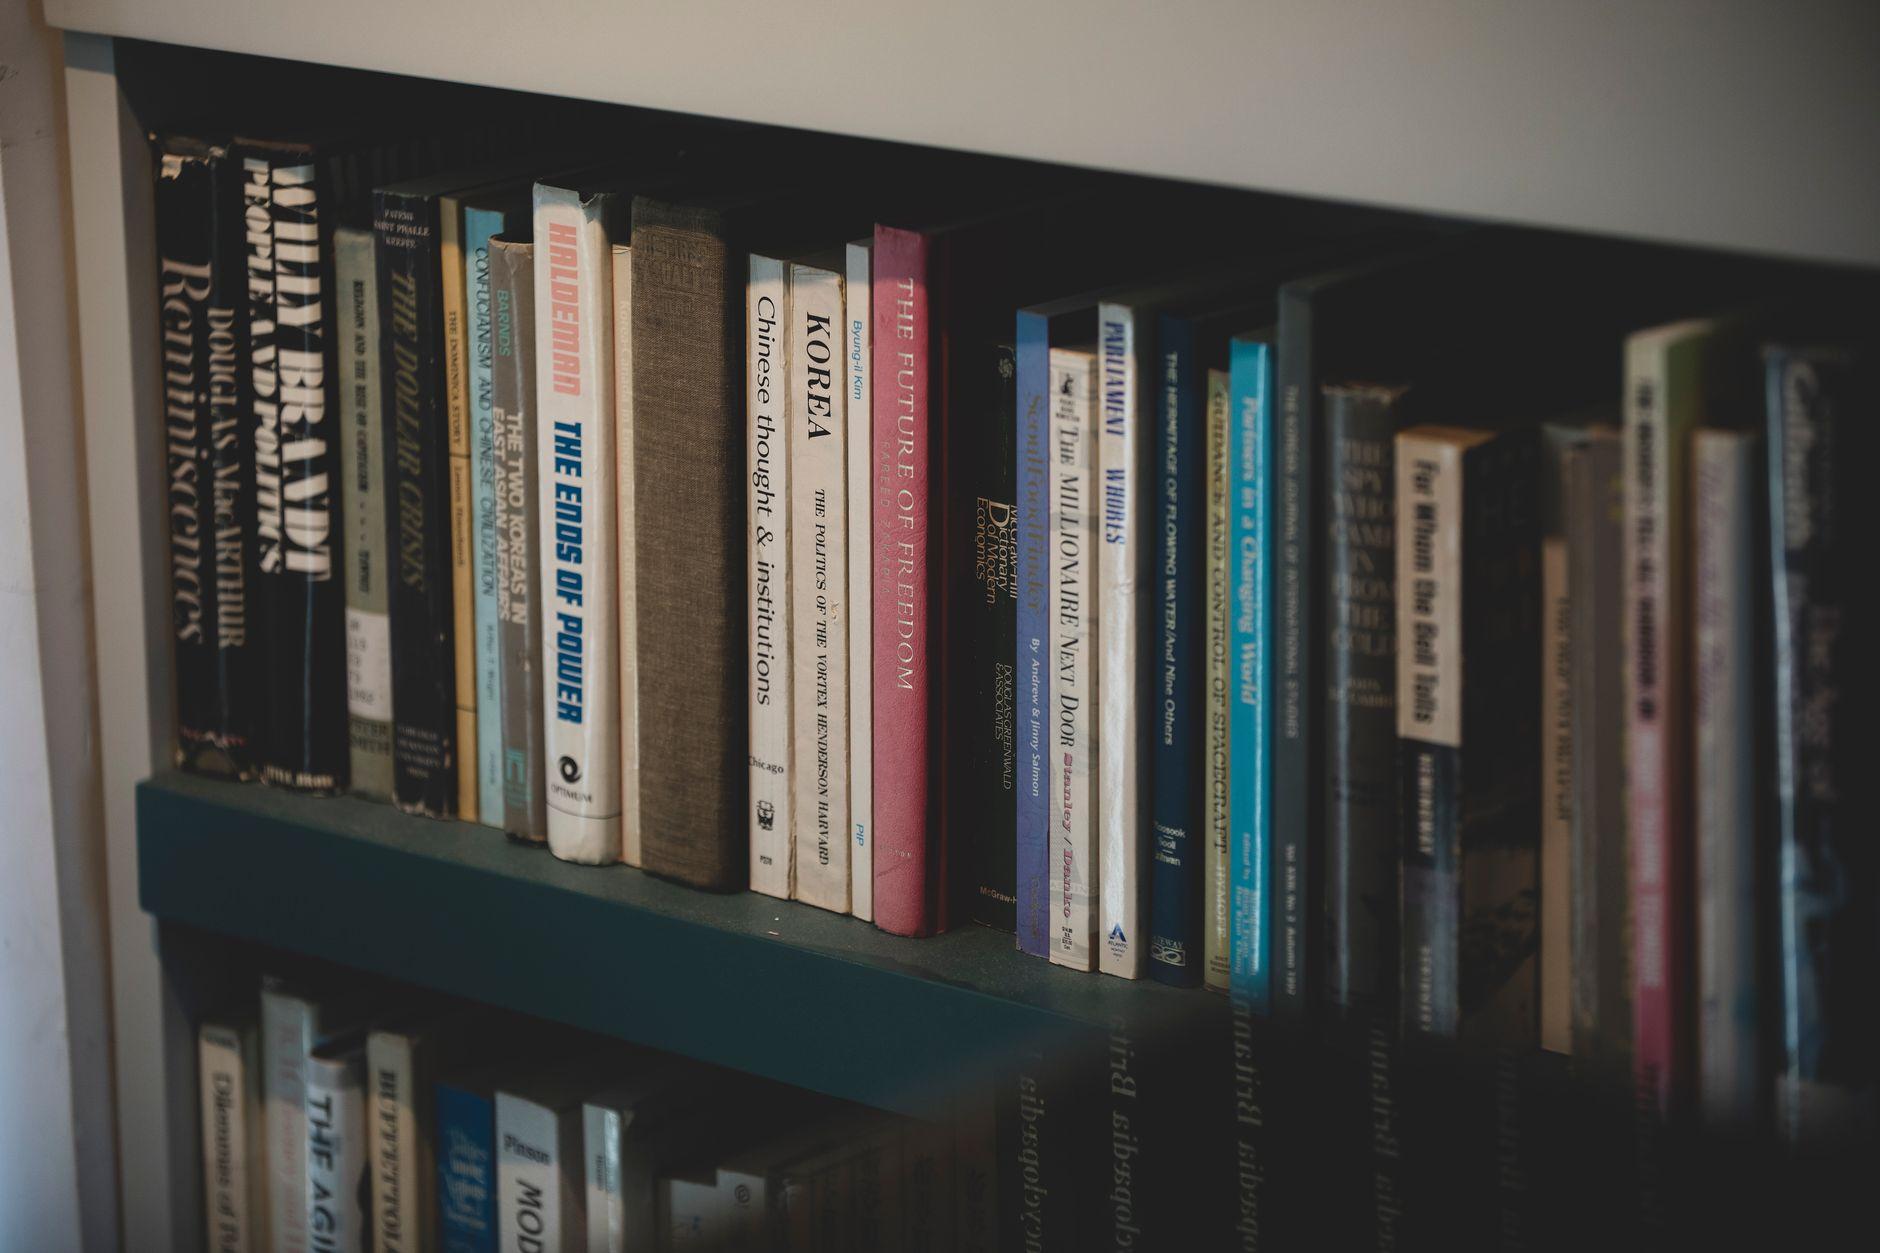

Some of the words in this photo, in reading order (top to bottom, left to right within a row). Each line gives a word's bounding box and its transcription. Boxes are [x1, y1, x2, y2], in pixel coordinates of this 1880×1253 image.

[243, 158, 273, 304] PEOPLE
[272, 164, 323, 338] WILLY
[391, 270, 417, 341] THE
[448, 311, 460, 338] THE
[474, 247, 491, 369] CONFUCIANISM
[497, 289, 511, 356] BARNDS
[548, 222, 580, 397] HALDEMAN
[896, 278, 914, 340] THE
[207, 307, 238, 450] DOUGLAS
[249, 307, 276, 397] AND
[757, 296, 777, 404] Chinese
[807, 311, 832, 440] KOREA
[852, 319, 864, 372] Byung-il
[1165, 351, 1179, 384] THE
[394, 341, 421, 475] DOLLAR
[478, 376, 493, 412] AND
[853, 375, 864, 401] Kim
[1105, 322, 1126, 438] PARLIAMENT
[451, 405, 463, 445] STORY
[492, 407, 506, 460] EAST
[506, 412, 523, 456] THE
[896, 351, 914, 479] FUTURE
[1059, 426, 1080, 465] THE
[1165, 386, 1179, 473] HERMITAGE
[1212, 392, 1227, 505] GUIDANCE
[1240, 396, 1257, 482] Partners
[161, 257, 212, 645] Reminiscences
[280, 350, 331, 581] BRANDT
[478, 417, 495, 488] CHINESE
[554, 420, 582, 478] THE
[752, 414, 777, 517] thought
[879, 438, 891, 507] FAREED
[1413, 459, 1440, 495] For
[253, 400, 282, 574] POLITICS
[493, 466, 508, 528] ASIAN
[507, 458, 524, 510] TWO
[814, 488, 827, 518] THE
[897, 488, 914, 530] OF
[1105, 468, 1126, 545] WHORES
[1165, 478, 1179, 501] OF
[1241, 487, 1258, 509] in
[212, 460, 246, 649] MacARTHUR
[399, 480, 425, 593] CRISIS
[479, 497, 496, 597] CIVILIZATION
[508, 514, 527, 595] KOREAS
[555, 482, 582, 564] ENDS
[756, 525, 774, 548] &
[975, 496, 988, 581] Economics
[986, 523, 998, 540] of
[987, 500, 1012, 592] Dictionary
[1059, 472, 1080, 627] MILLIONAIRE
[1164, 503, 1179, 576] FLOWING
[1212, 511, 1227, 561] AND
[1242, 515, 1255, 530] a
[1413, 502, 1439, 573] Whom
[496, 537, 510, 620] AFFAIRS
[556, 568, 582, 606] OF
[814, 523, 827, 590] POLITICS
[986, 542, 999, 605] Modern
[1238, 535, 1258, 634] Changing
[510, 602, 528, 626] IN
[815, 595, 827, 616] OF
[896, 540, 915, 690] FREEDOM
[1212, 567, 1227, 670] CONTROL
[1414, 578, 1439, 614] the
[756, 560, 775, 706] institutions
[815, 620, 827, 648] THE
[1029, 637, 1040, 653] By
[1059, 633, 1080, 687] NEXT
[1414, 620, 1440, 667] Bell
[556, 612, 583, 724] POWER
[816, 654, 828, 708] VORTEX
[1002, 664, 1013, 720] DOUGLAS
[1031, 658, 1041, 705] Andrew
[1164, 664, 1177, 695] Nine
[1212, 677, 1227, 708] OF
[1240, 641, 1258, 704] World
[1414, 673, 1440, 725] Tolls
[993, 671, 1005, 741] ASSOCIATES
[1029, 718, 1041, 750] Jinny
[1031, 707, 1041, 717] &
[1060, 693, 1080, 747] DOOR
[1163, 698, 1177, 746] Others
[748, 756, 785, 775] Chicago
[816, 713, 829, 797] HENDERSON
[1002, 720, 1013, 790] GREENWALD
[1031, 753, 1041, 797] Salmon
[1212, 711, 1228, 855] SPACECRAFT
[1062, 751, 1075, 834] Stanley
[817, 800, 829, 866] HARVARD
[855, 823, 864, 847] PIP
[1062, 849, 1074, 919] Danko
[309, 1096, 334, 1172] THE
